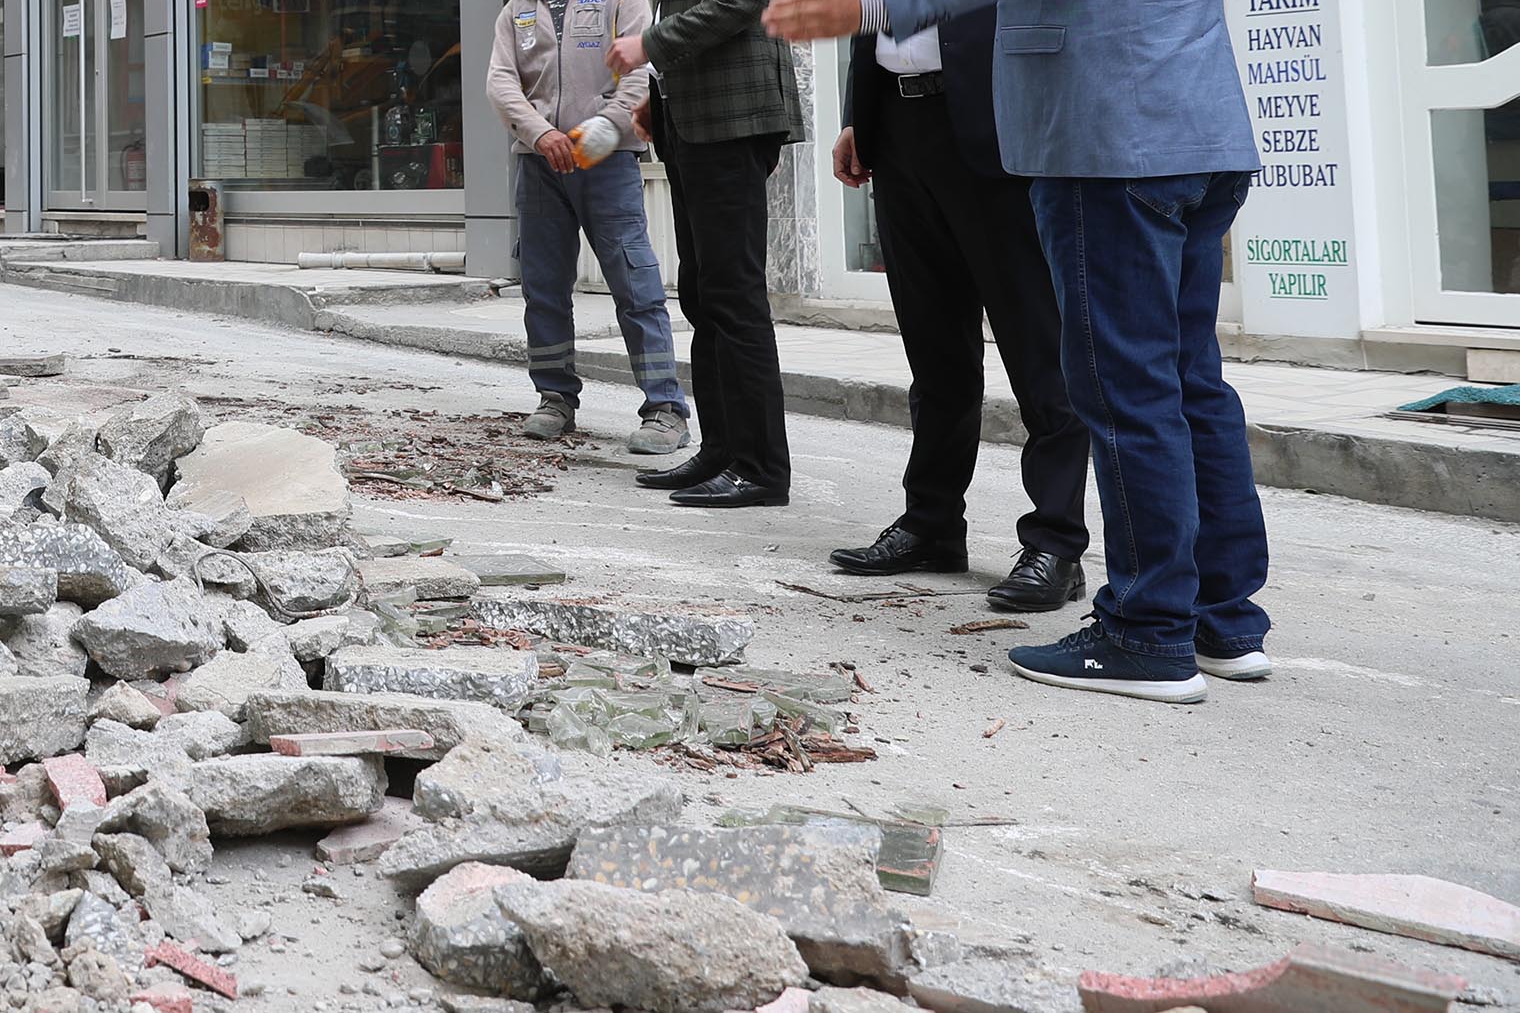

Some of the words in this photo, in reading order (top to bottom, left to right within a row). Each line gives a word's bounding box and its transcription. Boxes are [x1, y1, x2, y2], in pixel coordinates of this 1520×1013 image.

[1247, 23, 1322, 52] HAYVAN
[1247, 54, 1326, 86] MAHSÜL
[1257, 93, 1321, 119] MEYVE
[1262, 128, 1320, 154] SEBZE
[1249, 163, 1338, 188] HUBUBAT
[1247, 235, 1348, 264] SİGORTALARI
[1268, 271, 1329, 298] YAPILIR
